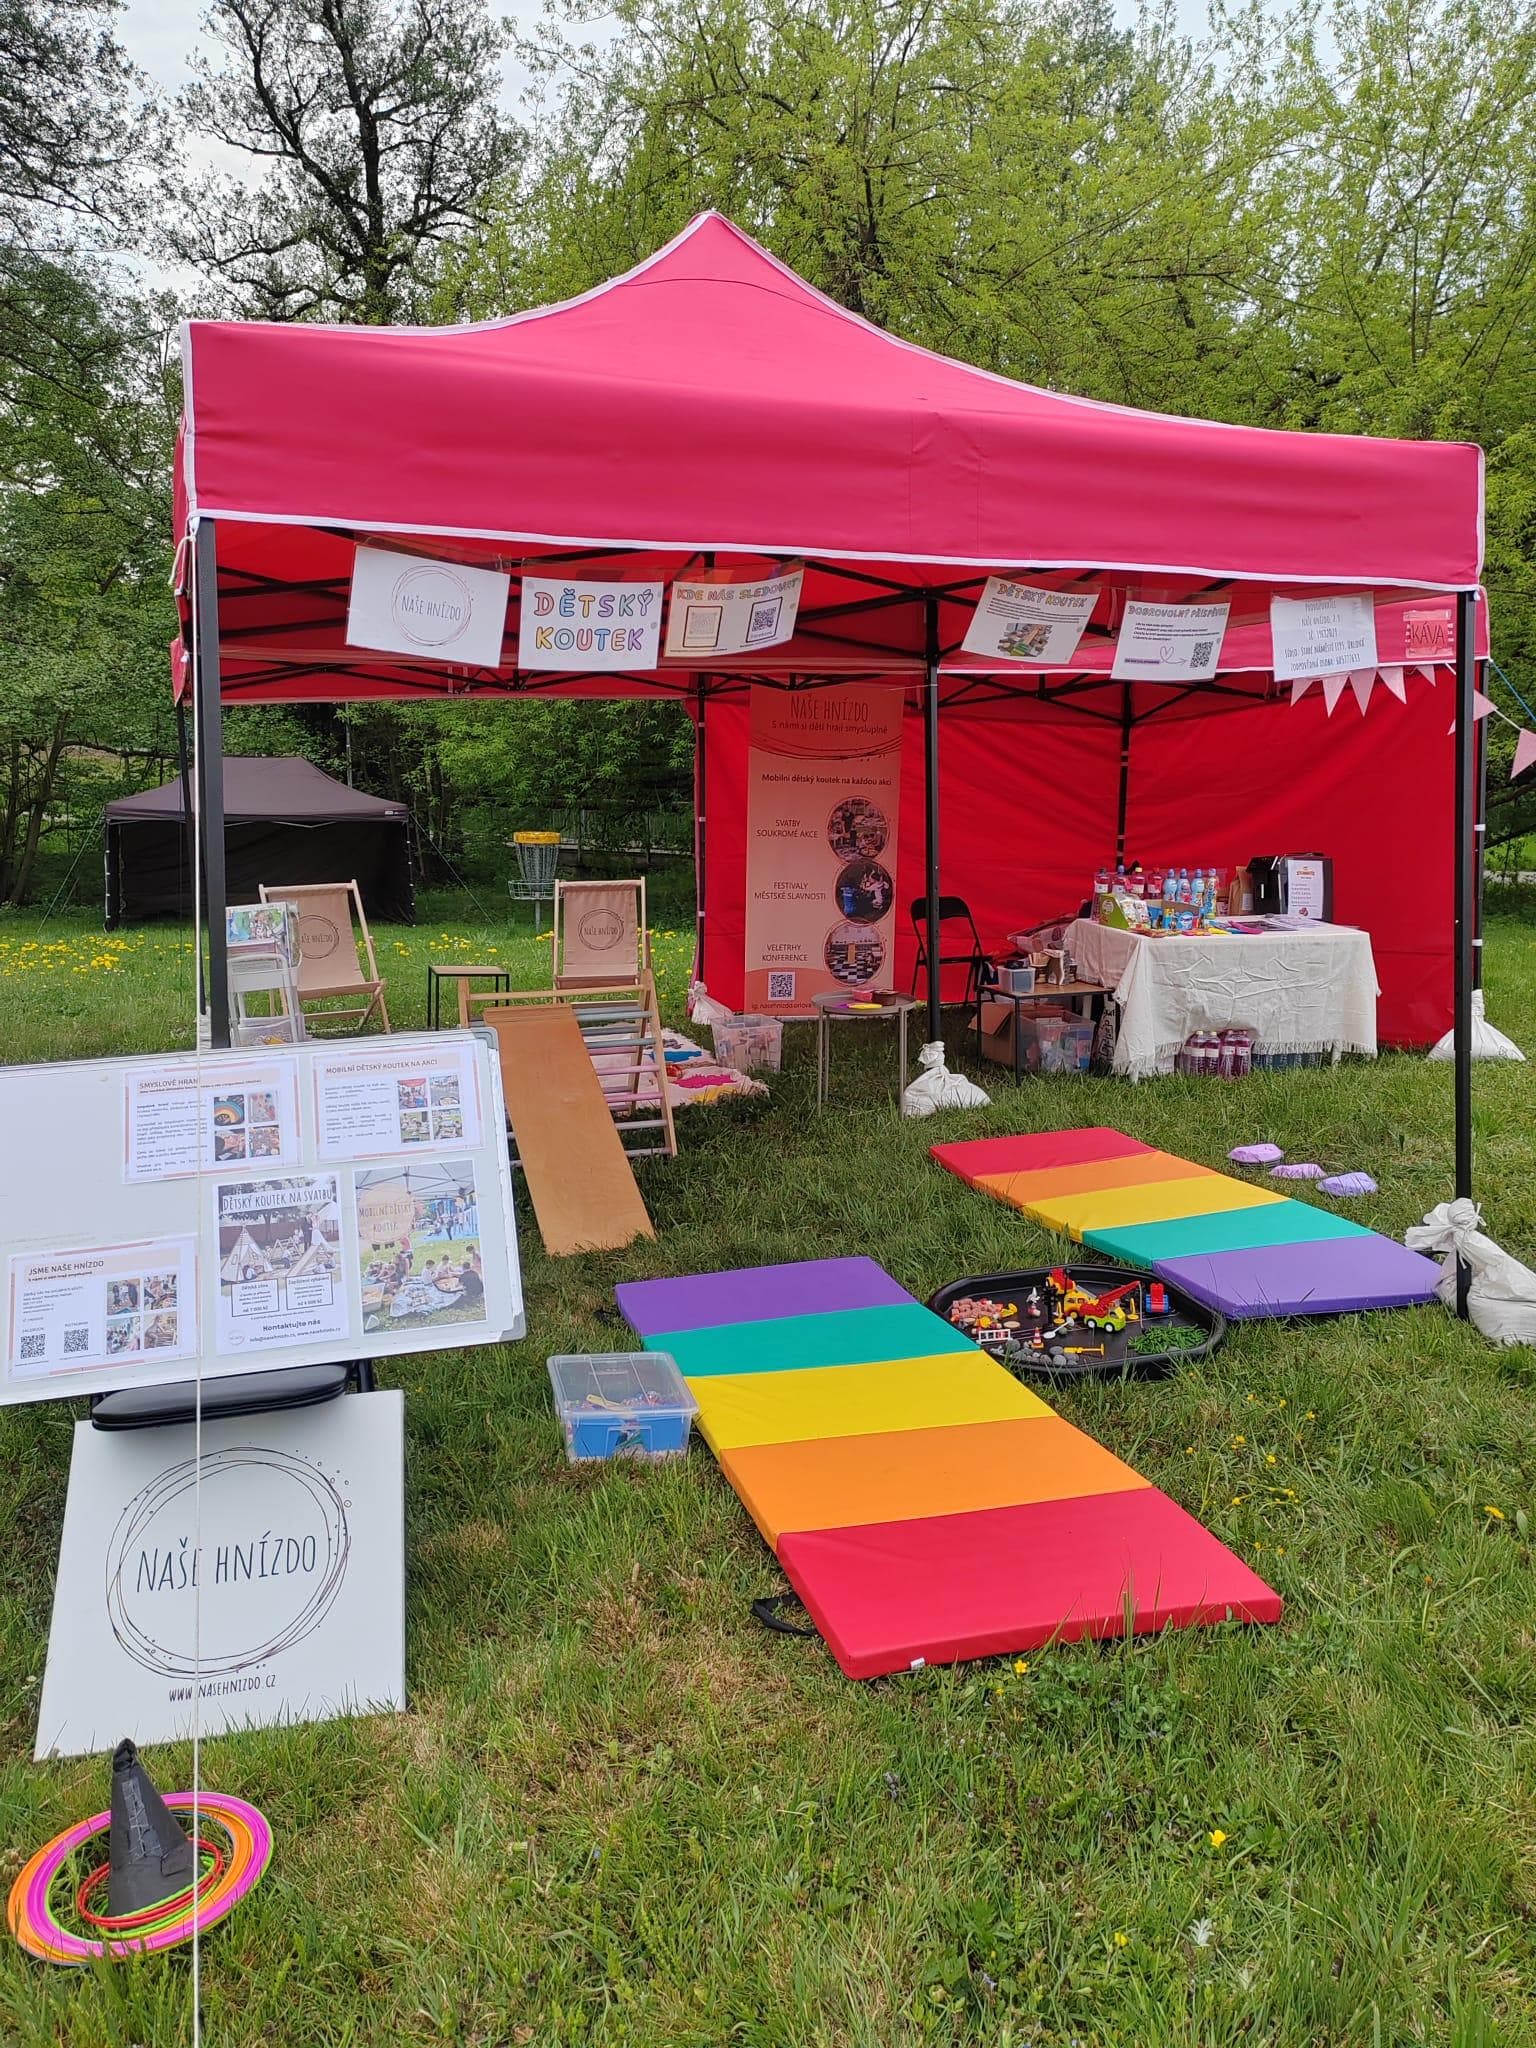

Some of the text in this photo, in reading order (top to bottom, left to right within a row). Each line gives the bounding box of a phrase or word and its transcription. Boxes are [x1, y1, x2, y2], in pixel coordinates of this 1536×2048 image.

[677, 588, 704, 601] KDE
[708, 588, 736, 601] NÁS
[996, 583, 1046, 604] DĚTSKÝ
[401, 595, 461, 621] NAŠE HNÍZDO
[533, 588, 654, 618] DĚTSKÝ
[1128, 605, 1191, 618] DOBROVOLNÝ
[535, 626, 644, 651] KOUTEK
[1411, 621, 1445, 645] KÁVA
[790, 693, 869, 722] NAŠE HNÍZDO
[772, 721, 888, 735] S námi si děti hrají smysluplně
[762, 774, 892, 785] Mobilní dětský koutek na každou akci
[775, 819, 800, 828] SVATBY
[756, 829, 818, 838] SOUKROMÉ AKCE
[773, 882, 808, 890] FESTIVALY
[754, 890, 826, 900] MĚSTSKÉ SLAVNOSTI
[766, 943, 801, 951] VELETRHY
[762, 953, 808, 962] KONFERENCE
[326, 1065, 355, 1074] MOBILNÍ
[356, 1062, 383, 1072] DĚTSKÝ
[383, 1060, 409, 1070] KOUTEK
[421, 1059, 438, 1067] AKCI
[139, 1078, 177, 1089] SMYSLOVÉ
[178, 1077, 199, 1086] HRAN
[223, 1188, 332, 1211] DĚTSKÝ KOUTEK NA SVATBU
[28, 1259, 104, 1276] JSME NAŠE HNÍZDO
[262, 1319, 321, 1332] Kontaktujte nás
[215, 1530, 316, 1585] HNÍZDO
